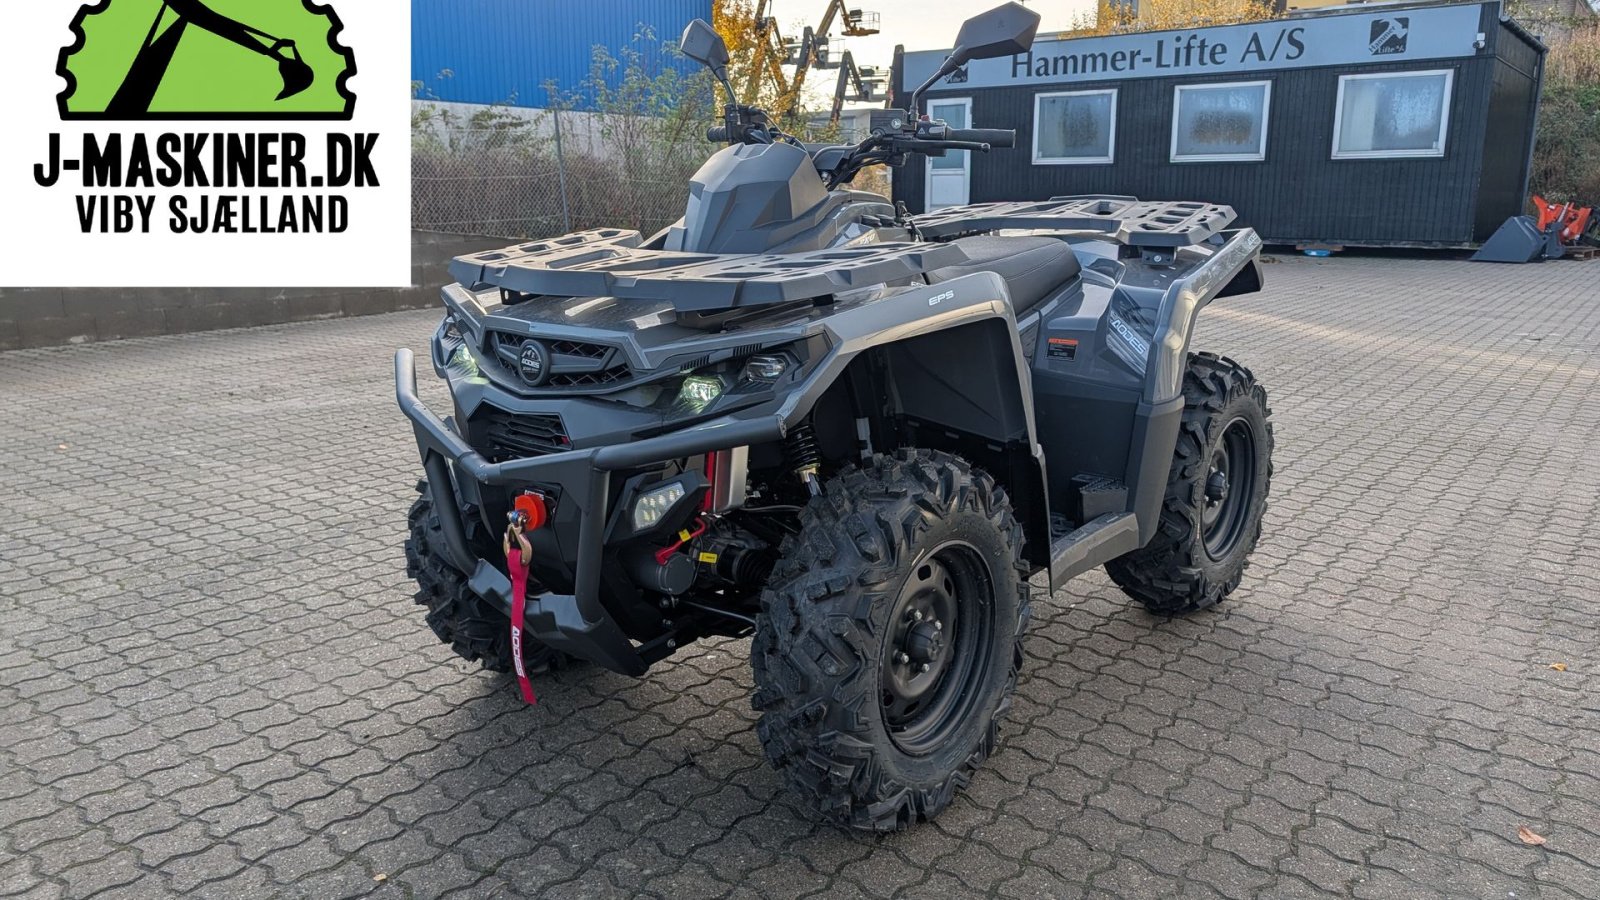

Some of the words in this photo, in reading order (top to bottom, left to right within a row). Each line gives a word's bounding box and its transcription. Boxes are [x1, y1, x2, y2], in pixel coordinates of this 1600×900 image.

[1011, 34, 1228, 78] Hammer-Lifte
[1240, 27, 1305, 63] A/S
[928, 289, 955, 306] EPS
[1111, 319, 1147, 355] AODES
[511, 625, 525, 678] AODES
